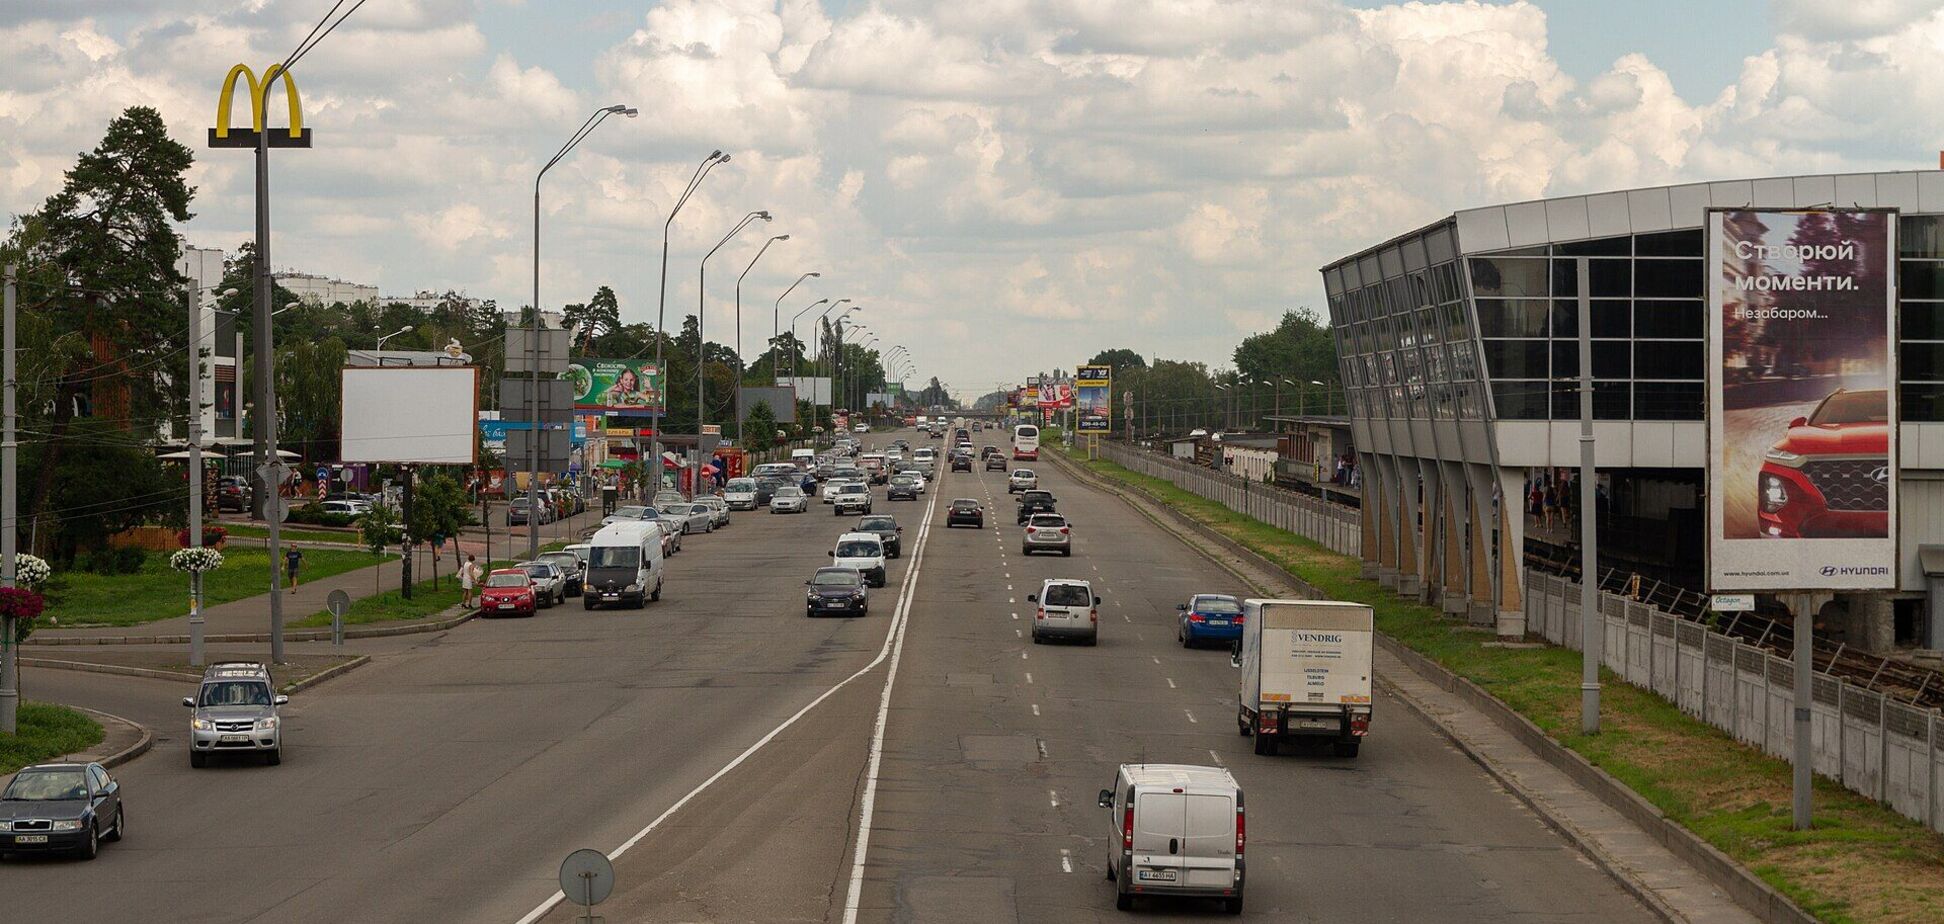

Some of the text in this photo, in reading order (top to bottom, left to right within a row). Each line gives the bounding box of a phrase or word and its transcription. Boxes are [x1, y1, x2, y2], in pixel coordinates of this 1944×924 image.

[1735, 240, 1854, 264] Створюй
[1735, 275, 1859, 291] моменти.
[1735, 307, 1828, 320] Незабаром...
[1723, 569, 1790, 577] www.hyundai.com.ua
[1840, 567, 1889, 575] HYUNDAI
[1298, 634, 1342, 643] VENDRIG
